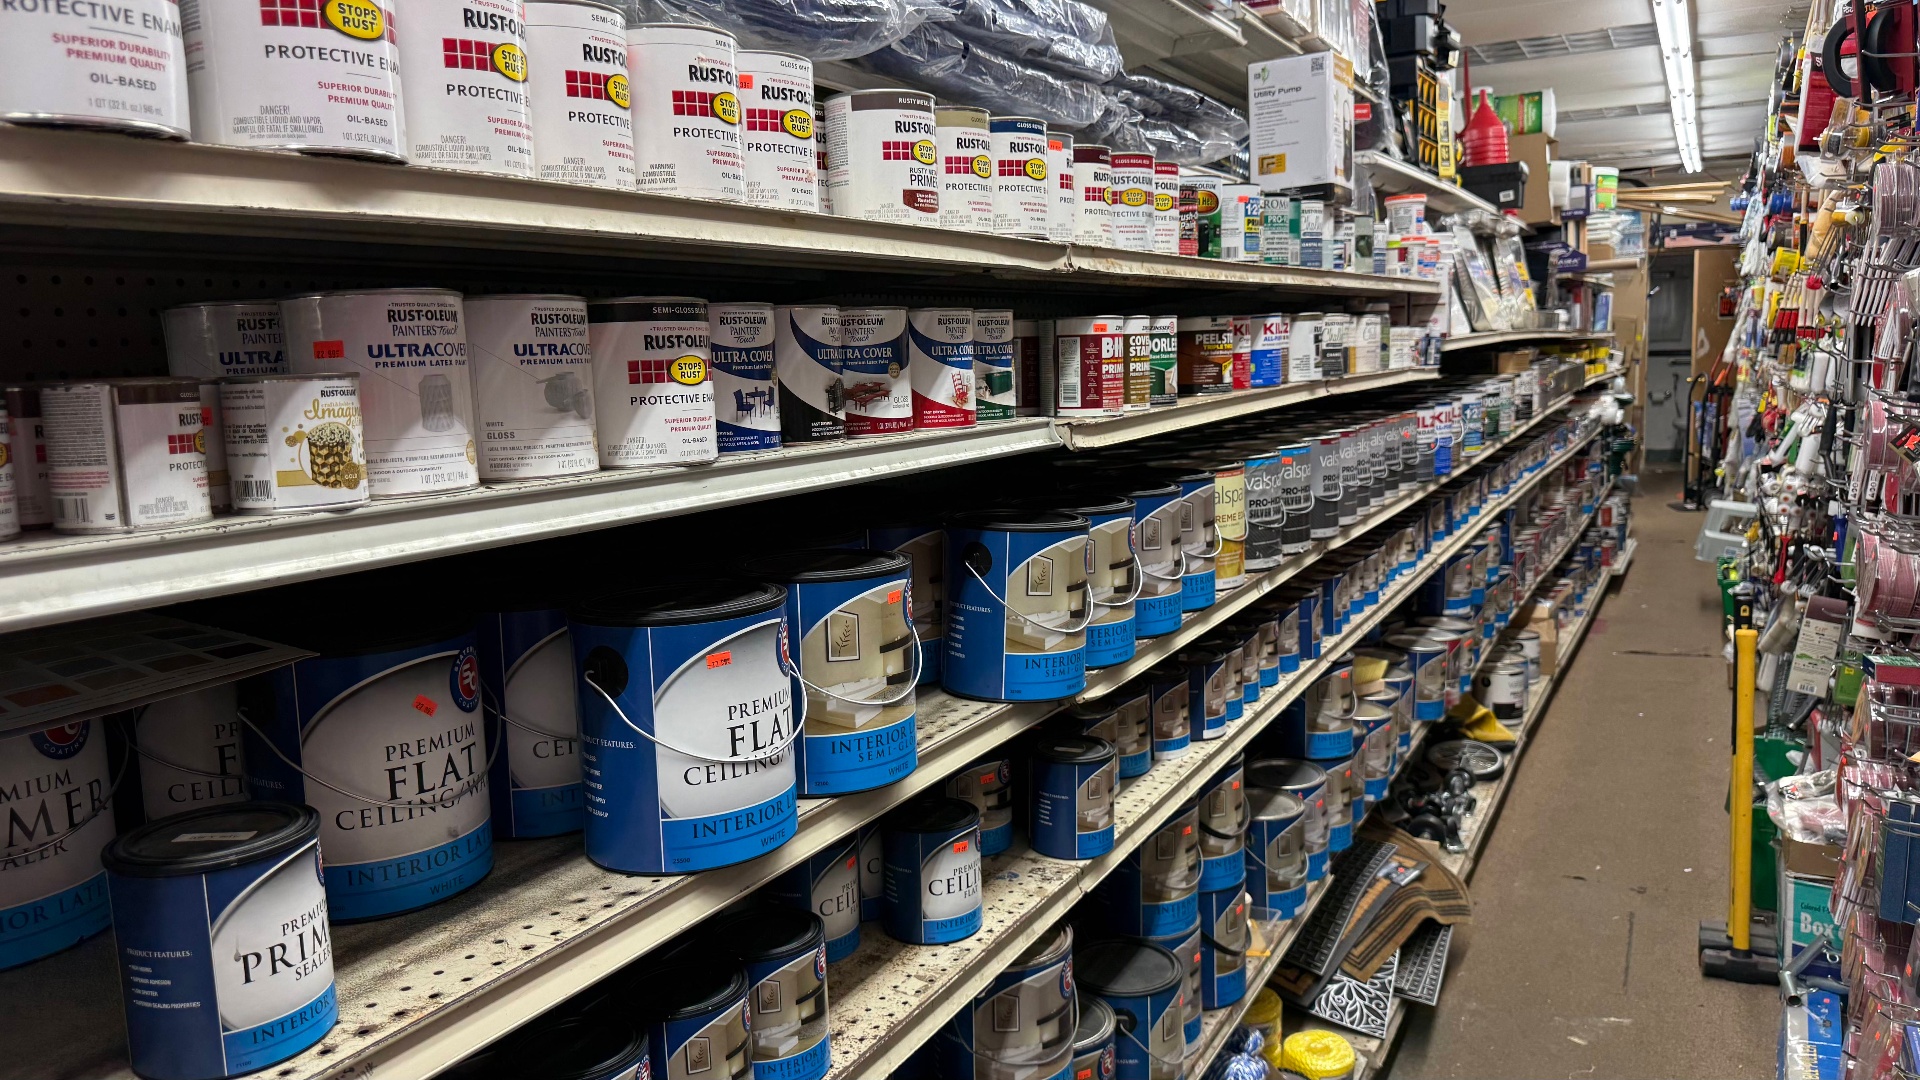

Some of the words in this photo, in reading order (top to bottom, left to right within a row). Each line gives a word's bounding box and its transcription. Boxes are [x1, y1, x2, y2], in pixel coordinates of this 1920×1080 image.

[0, 0, 135, 26] ROTECTIVE
[338, 2, 377, 20] STOPS
[342, 15, 375, 32] RUST
[52, 33, 116, 49] SUPERIOR
[119, 41, 171, 60] DURABILITY
[66, 49, 126, 64] PREMIUM
[130, 59, 166, 72] QUALITY
[265, 44, 375, 67] PROTECTIVE
[501, 50, 524, 65] STOPS
[504, 61, 524, 73] RUST
[780, 60, 798, 70] GLOSS
[90, 72, 157, 91] OIL-BASED
[613, 80, 630, 92] STOPS
[317, 81, 362, 93] SUPERIOR
[364, 86, 397, 100] DURABILITY
[446, 83, 524, 105] PROTECTIVE
[615, 89, 630, 100] RUST
[1254, 89, 1276, 99] Utility
[1278, 86, 1302, 96] Pump
[327, 94, 370, 107] PREMIUM
[371, 99, 395, 112] QUALITY
[719, 98, 740, 110] STOPS
[898, 97, 915, 105] RUSTY
[260, 105, 290, 115] DANGER!
[721, 106, 739, 118] RUST
[289, 117, 301, 126] AND
[347, 114, 388, 127] OIL-BASED
[487, 115, 517, 127] SUPERIOR
[568, 111, 630, 130] PROTECTIVE
[789, 114, 810, 126] STOPS
[791, 123, 809, 133] RUST
[673, 127, 738, 144] PROTECTIVE
[706, 149, 732, 160] SUPERIOR
[747, 142, 809, 157] PROTECTIVE
[918, 145, 935, 154] STOPS
[920, 152, 933, 160] RUST
[649, 163, 676, 171] WARNING!
[976, 159, 990, 168] STOPS
[1030, 162, 1044, 171] STOPS
[909, 167, 927, 175] RUSTY
[978, 166, 990, 175] RUST
[1031, 169, 1043, 177] RUST
[946, 183, 989, 192] PROTECTIVE
[998, 184, 1043, 194] PROTECTIVE
[391, 302, 417, 310] TRUSTED
[652, 306, 695, 315] SEMI-GLOSS
[387, 309, 458, 324] RUST-OLEUM
[531, 312, 587, 326] RUST-OLEUM
[719, 315, 768, 327] RUST-OLEUM
[937, 317, 971, 328] RUST-OLEUM
[652, 326, 676, 334] TRUSTED
[1195, 333, 1221, 346] PEEL
[712, 351, 748, 364] ULTRA
[749, 350, 774, 364] COVER
[868, 347, 893, 358] COVER
[931, 346, 958, 358] ULTRA
[375, 359, 427, 370] PREMIUM
[429, 358, 453, 368] LATEX
[520, 358, 563, 368] PREMIUM
[565, 358, 584, 366] LATEX
[677, 361, 702, 372] STOPS
[226, 366, 279, 376] PREMIUM
[680, 370, 701, 380] RUST
[630, 394, 701, 407] PROTECTIVE
[664, 416, 692, 425] SUPERIOR
[486, 431, 515, 440] GLOSS
[670, 425, 696, 434] PREMIUM
[1024, 652, 1082, 671] INTERIOR
[1112, 650, 1130, 661] WHITE
[727, 705, 792, 760] FLAT
[385, 721, 476, 763] PREMIUM
[601, 739, 637, 749] FEATURES:
[831, 728, 907, 756] INTERIOR
[384, 742, 478, 802] FLAT
[888, 761, 909, 777] WHITE
[0, 768, 73, 804] MIUM
[692, 801, 785, 840] INTERIOR
[760, 829, 787, 849] WHITE
[347, 845, 461, 888] INTERIOR
[430, 874, 465, 896] WHITE
[963, 884, 979, 900] FLAT
[1800, 902, 1822, 914] Colored
[1800, 911, 1835, 940] Box
[126, 947, 153, 959] PRODUCT
[153, 949, 193, 960] FEATURES:
[253, 994, 329, 1047] INTERIOR
